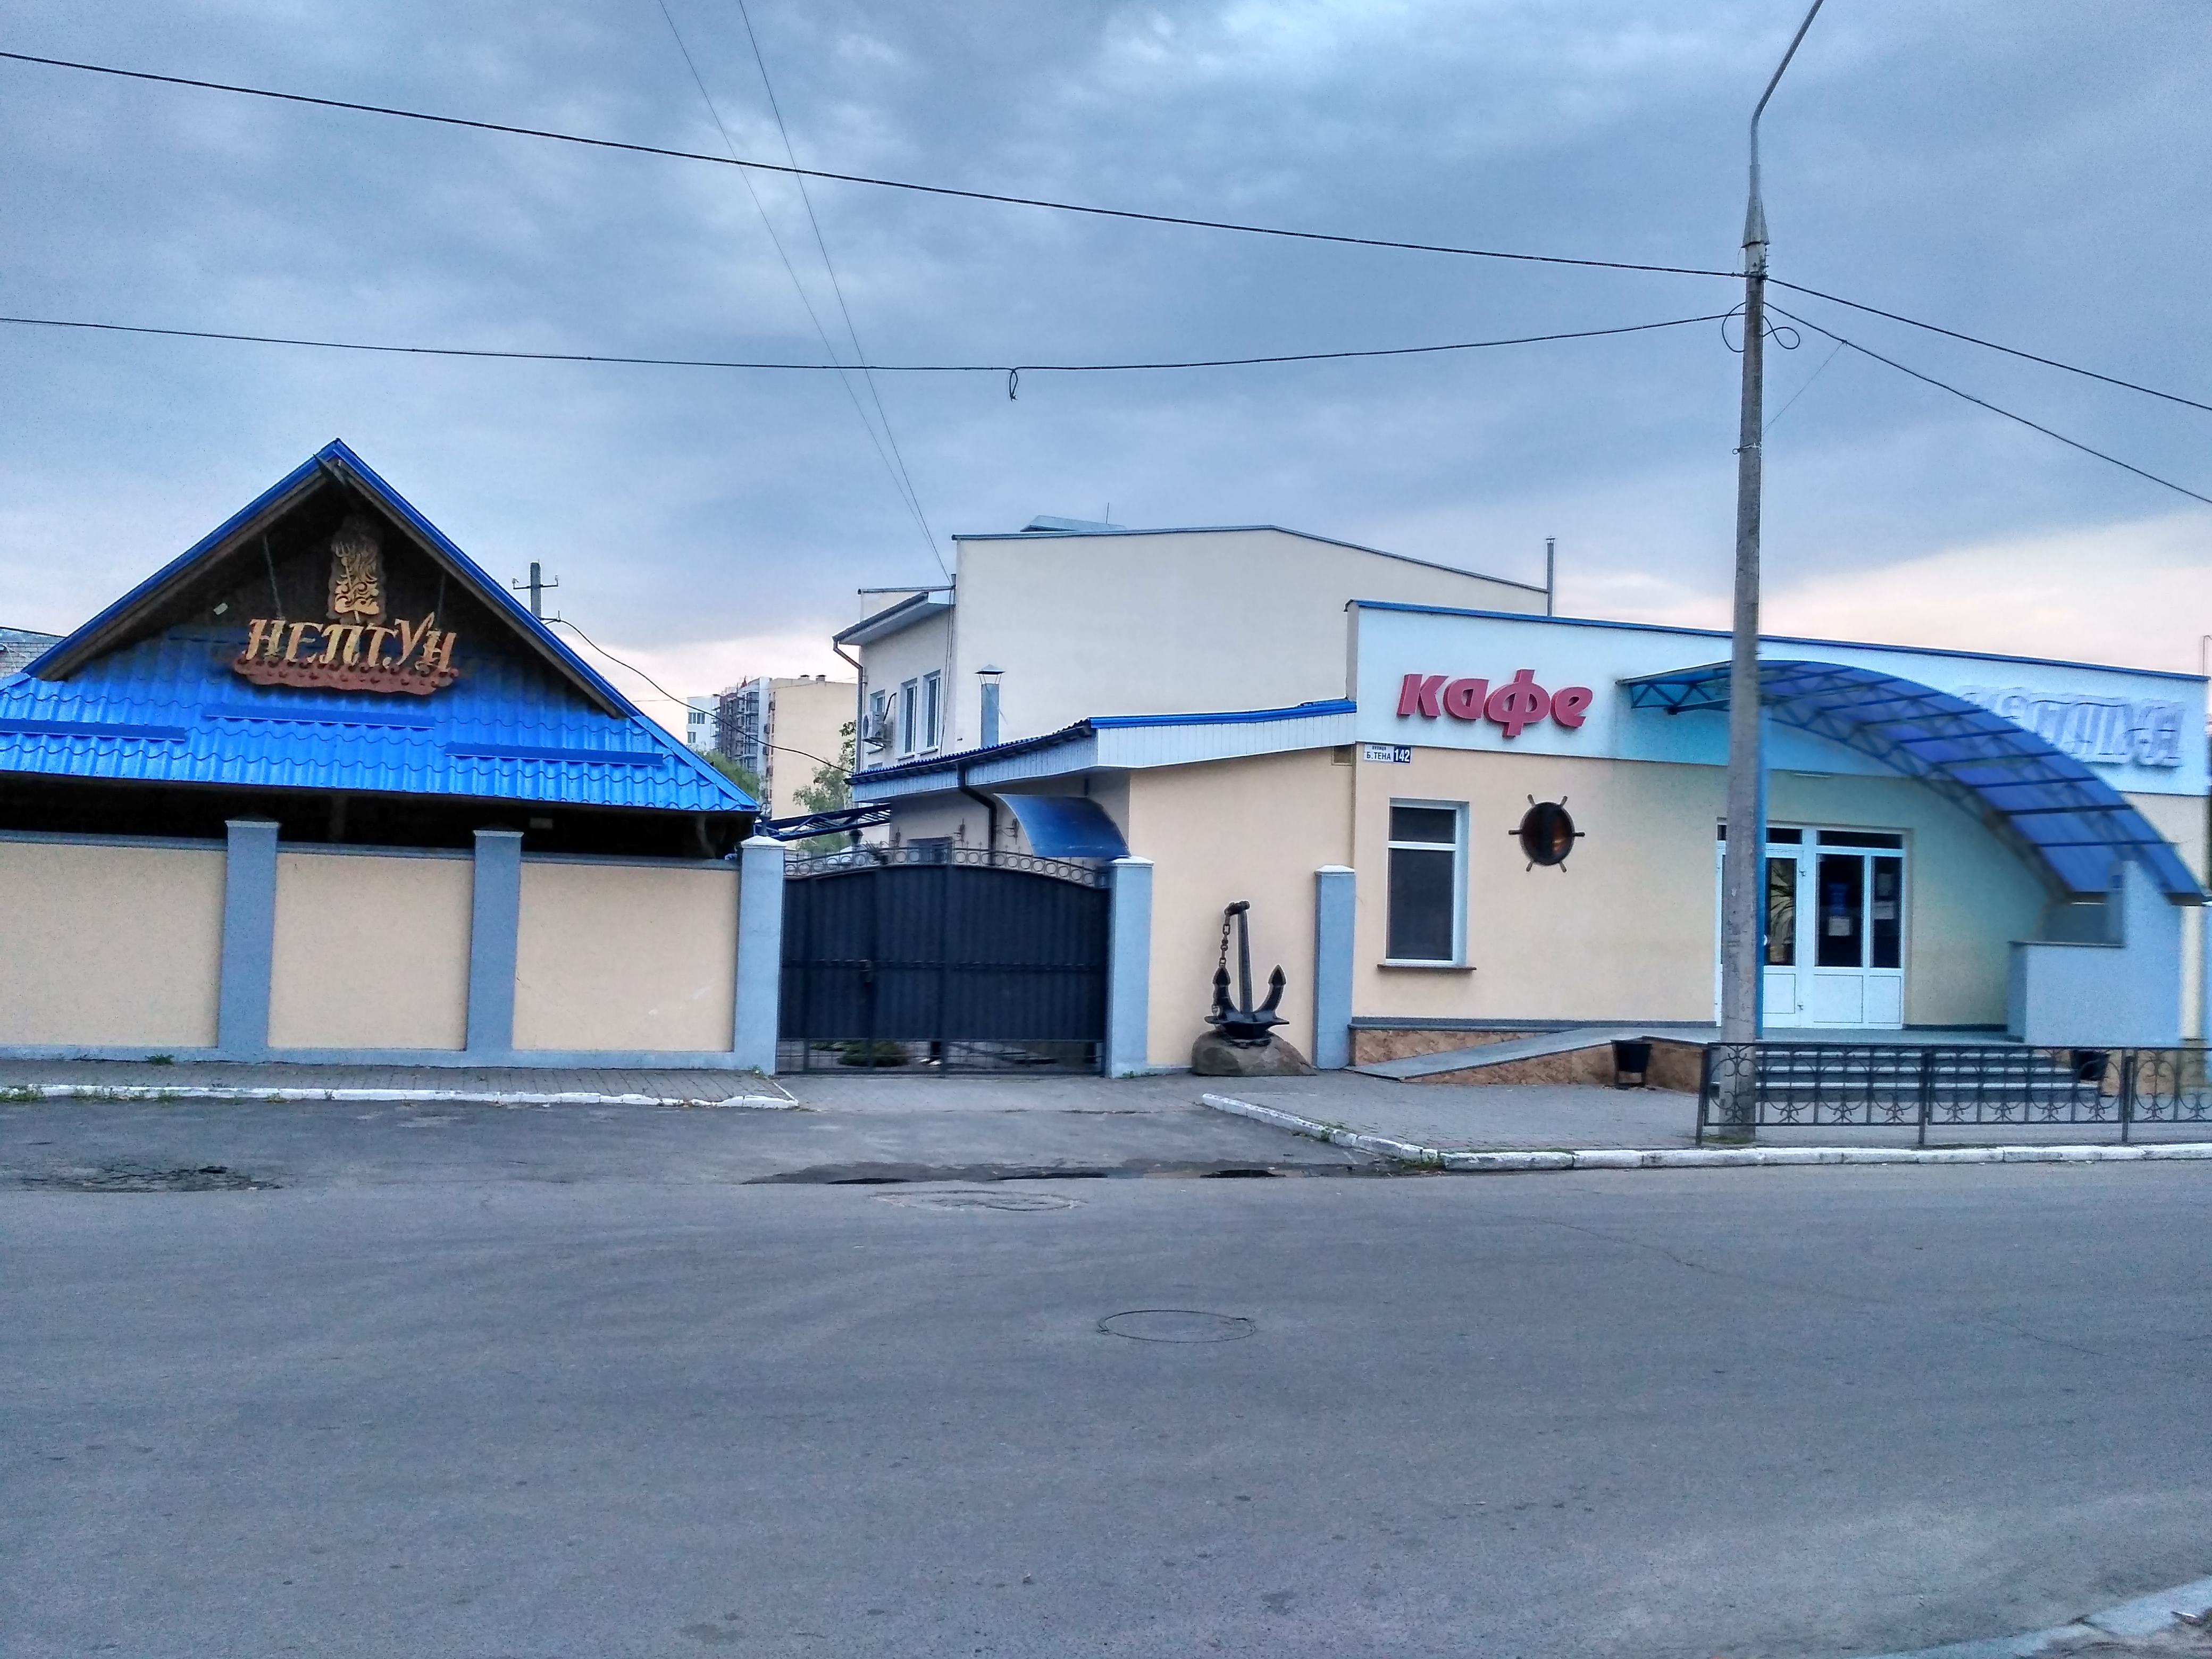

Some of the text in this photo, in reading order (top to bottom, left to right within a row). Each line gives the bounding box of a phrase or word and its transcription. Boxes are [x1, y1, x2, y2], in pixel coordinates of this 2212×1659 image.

[243, 612, 456, 672] НЕПТУН
[1397, 669, 1593, 737] кафе
[1367, 749, 1410, 762] Б.ТЕНА 142
